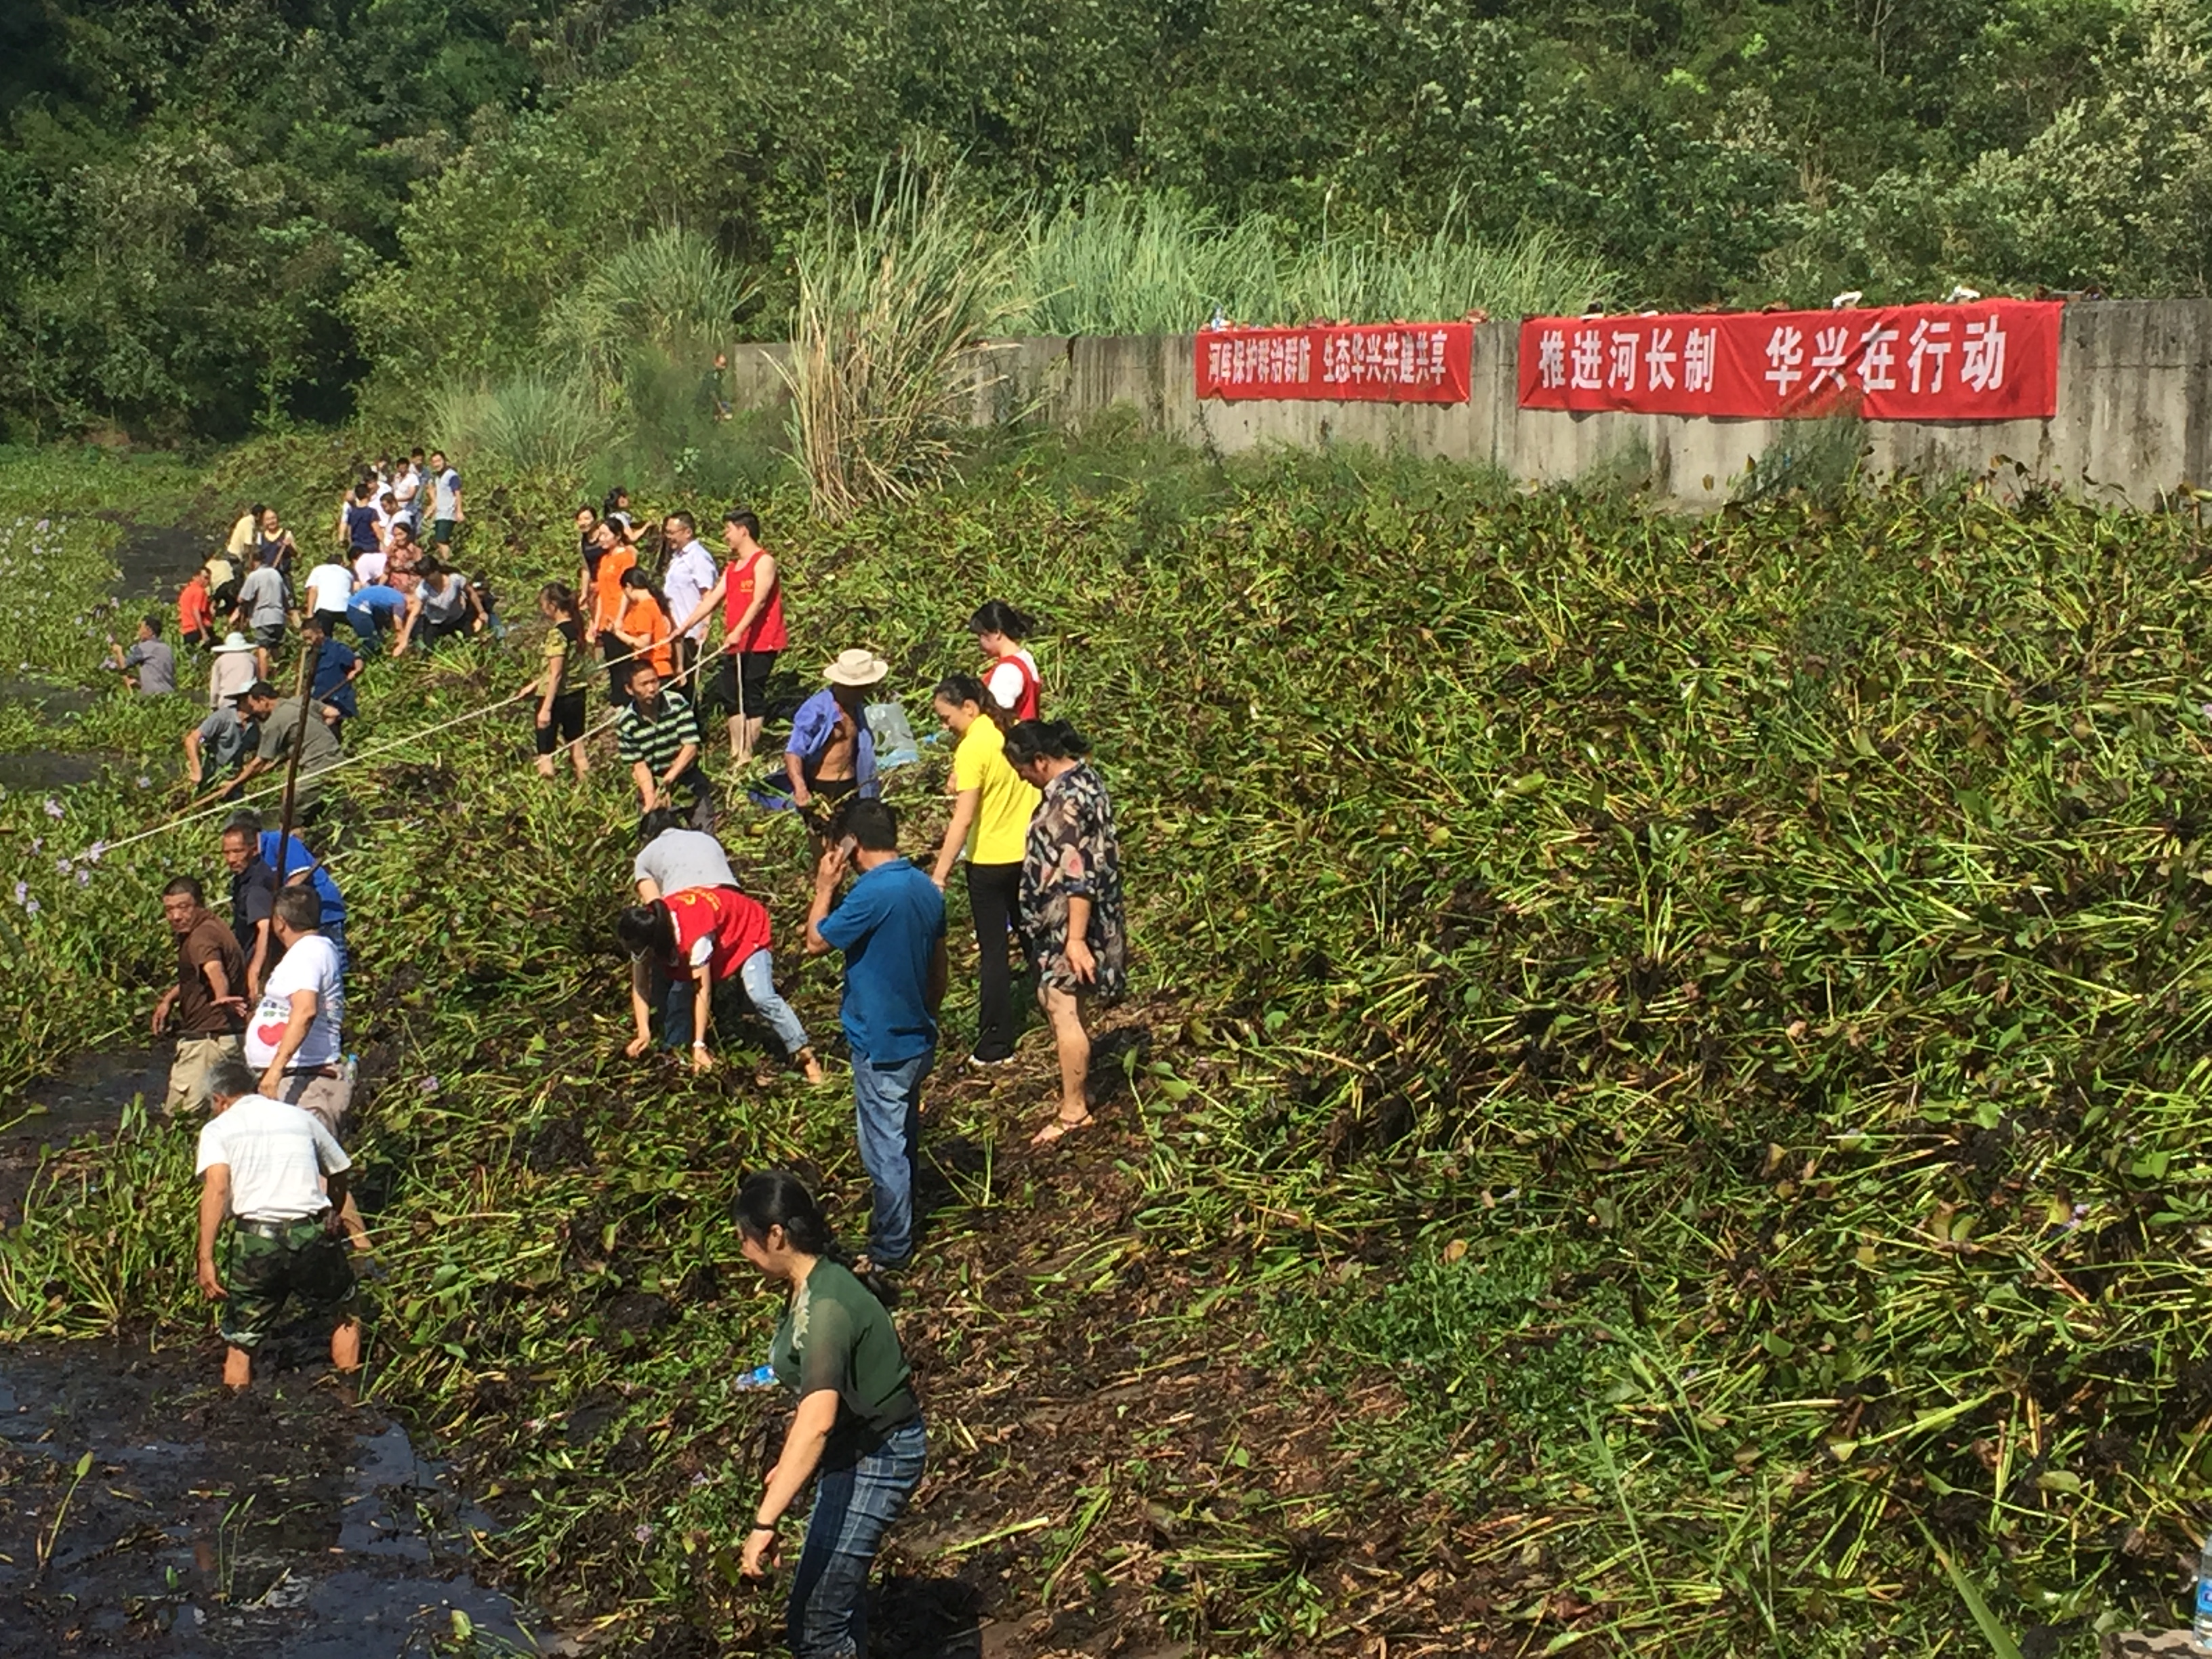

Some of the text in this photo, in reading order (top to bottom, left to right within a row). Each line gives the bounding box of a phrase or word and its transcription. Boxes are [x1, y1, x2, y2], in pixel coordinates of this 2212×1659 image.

[1322, 329, 1448, 386] 生态华兴共建共享
[1538, 314, 2007, 396] 推进河长制 华兴在行动
